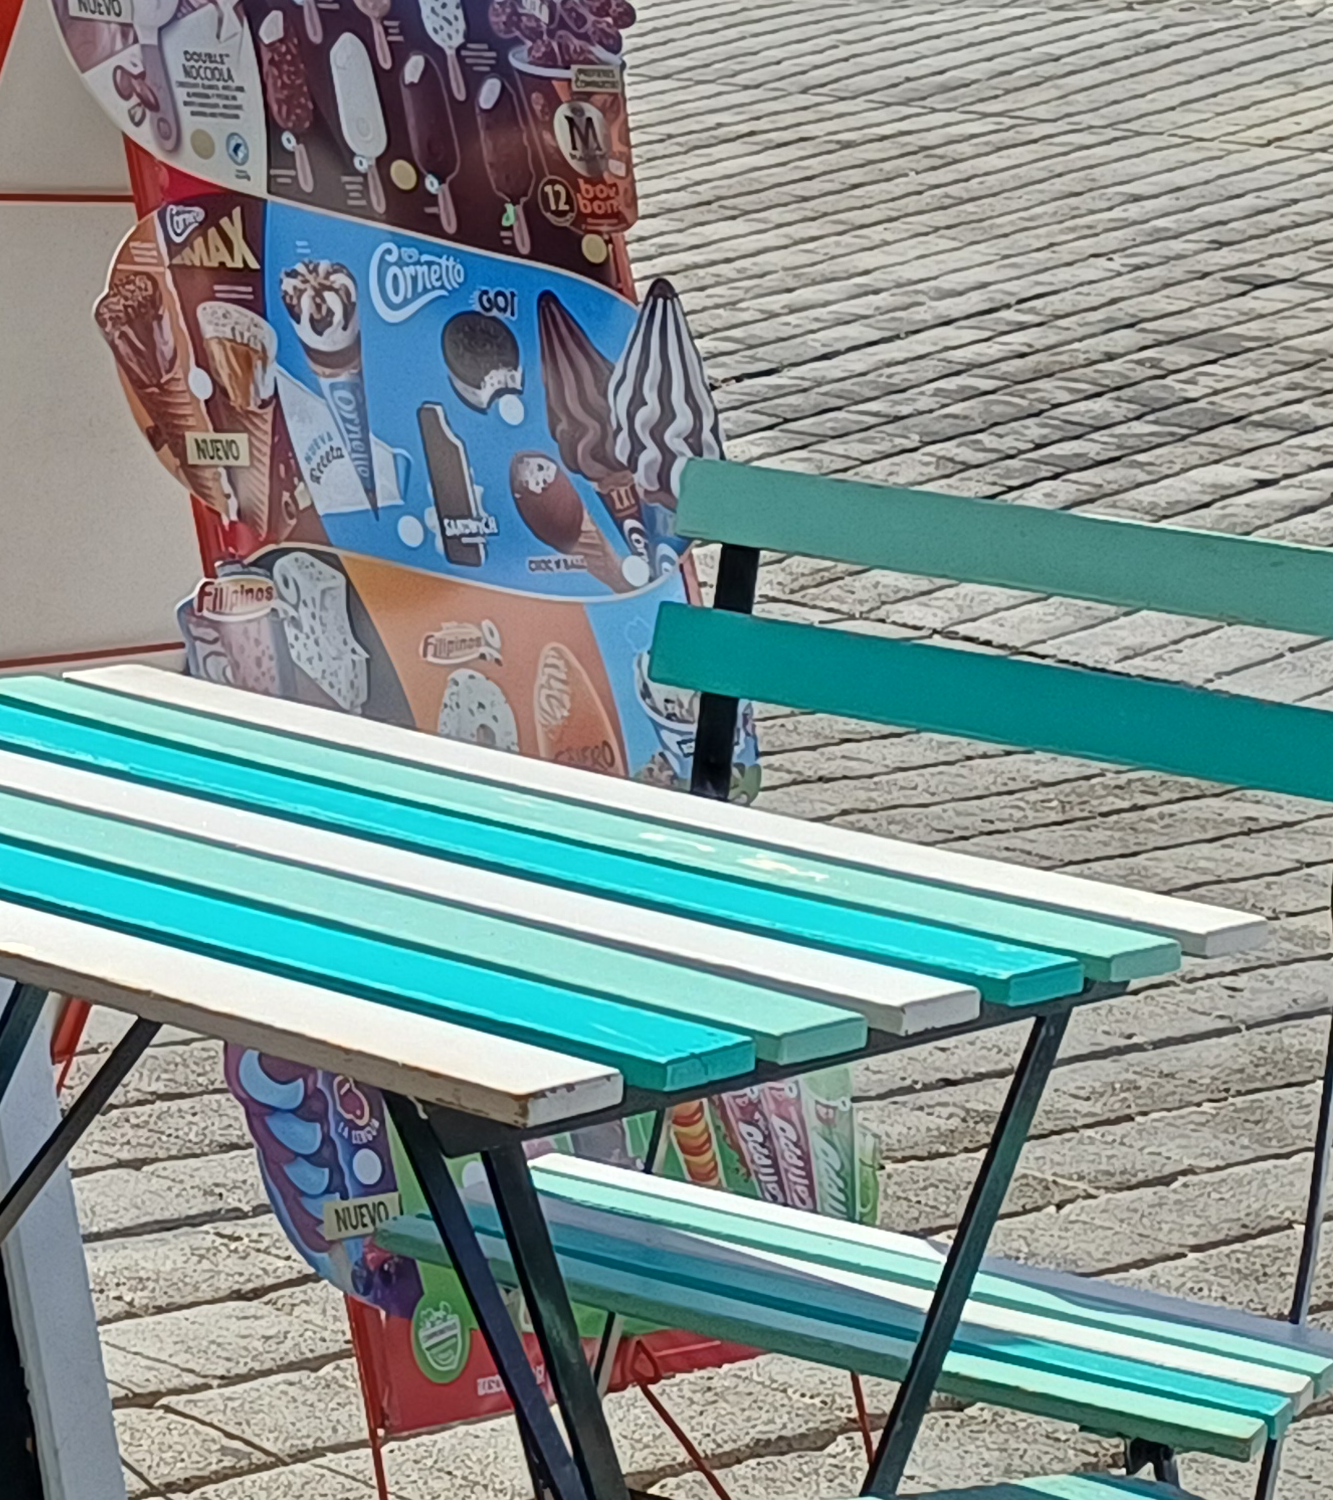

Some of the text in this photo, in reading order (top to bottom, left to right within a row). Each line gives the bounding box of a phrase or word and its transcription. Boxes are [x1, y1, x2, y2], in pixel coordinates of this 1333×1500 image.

[183, 49, 226, 65] DOUBLE
[564, 114, 603, 152] M
[544, 184, 570, 211] 12
[368, 242, 465, 324] Cornetto
[193, 437, 240, 462] NUEVO
[304, 431, 334, 466] NUEVA
[334, 1200, 389, 1233] NUEVO
